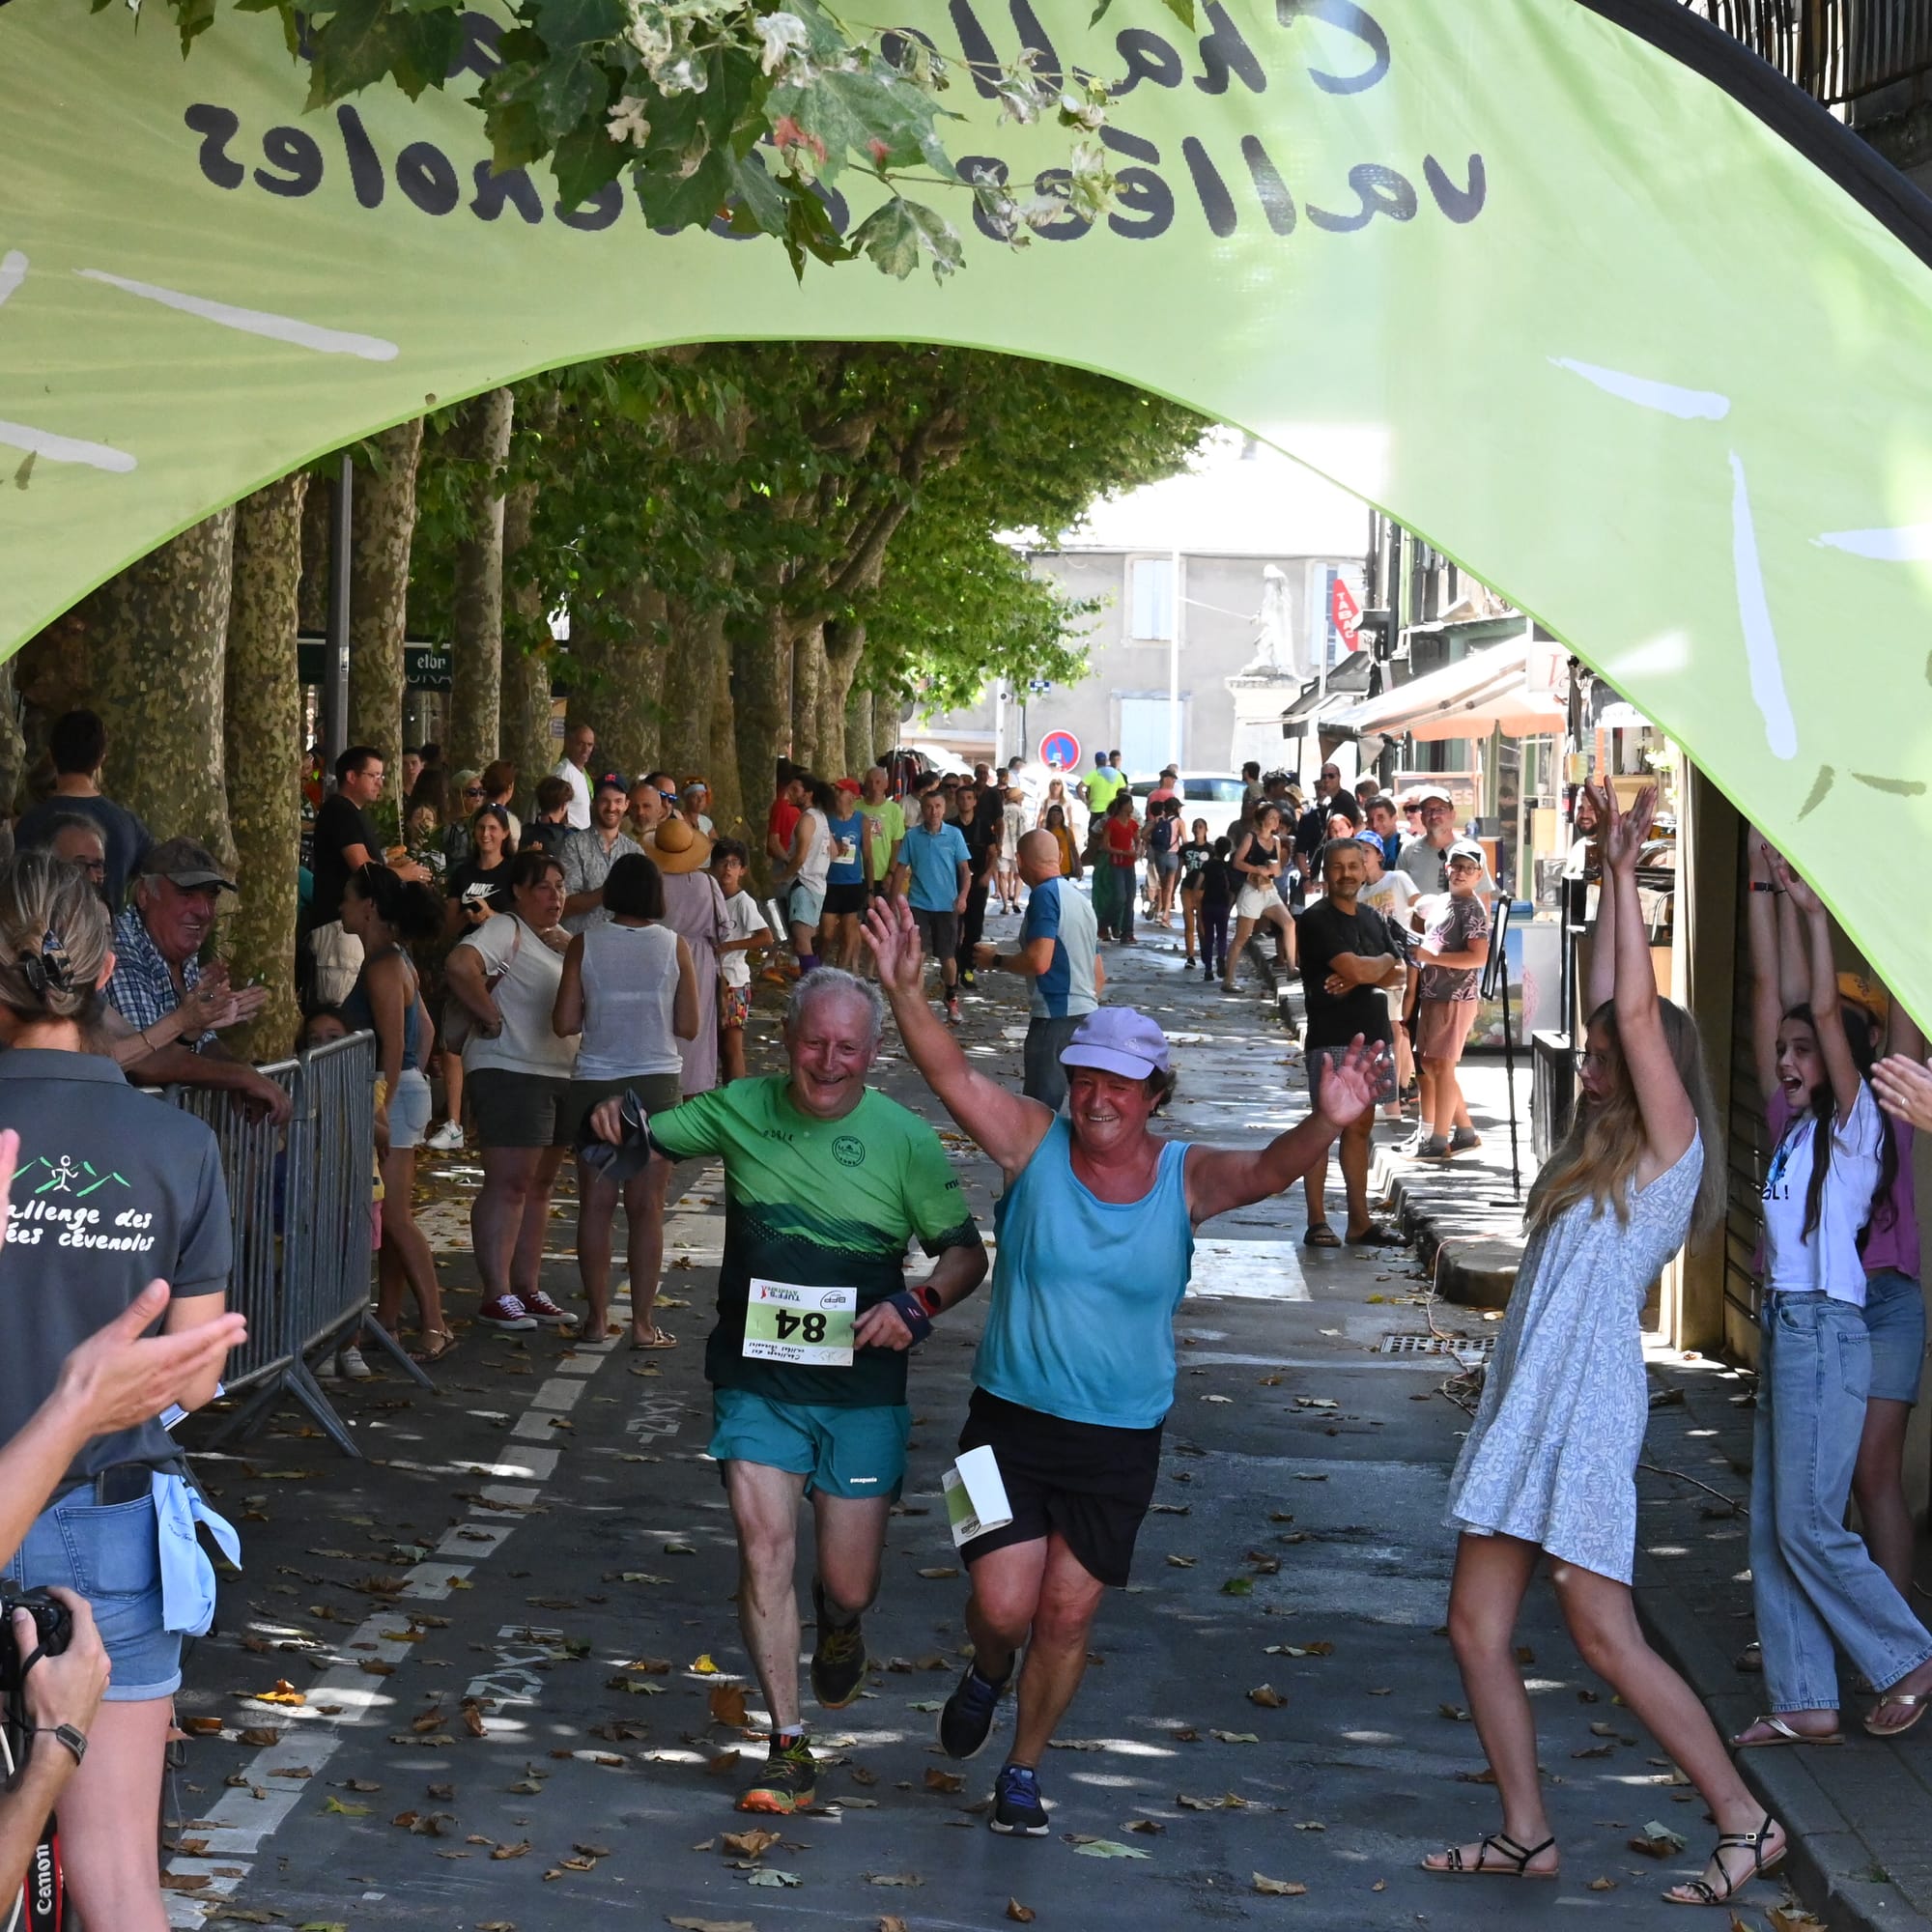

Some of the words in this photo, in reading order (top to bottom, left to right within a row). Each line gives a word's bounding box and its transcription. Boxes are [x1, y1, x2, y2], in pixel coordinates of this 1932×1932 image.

[1336, 591, 1355, 639] TABAC
[1451, 788, 1474, 806] ES
[467, 882, 495, 895] NIKE
[8, 1200, 99, 1230] allenge
[115, 1208, 153, 1229] des
[6, 1222, 43, 1244] ées
[775, 1308, 827, 1344] 84
[36, 1843, 53, 1916] Canon
